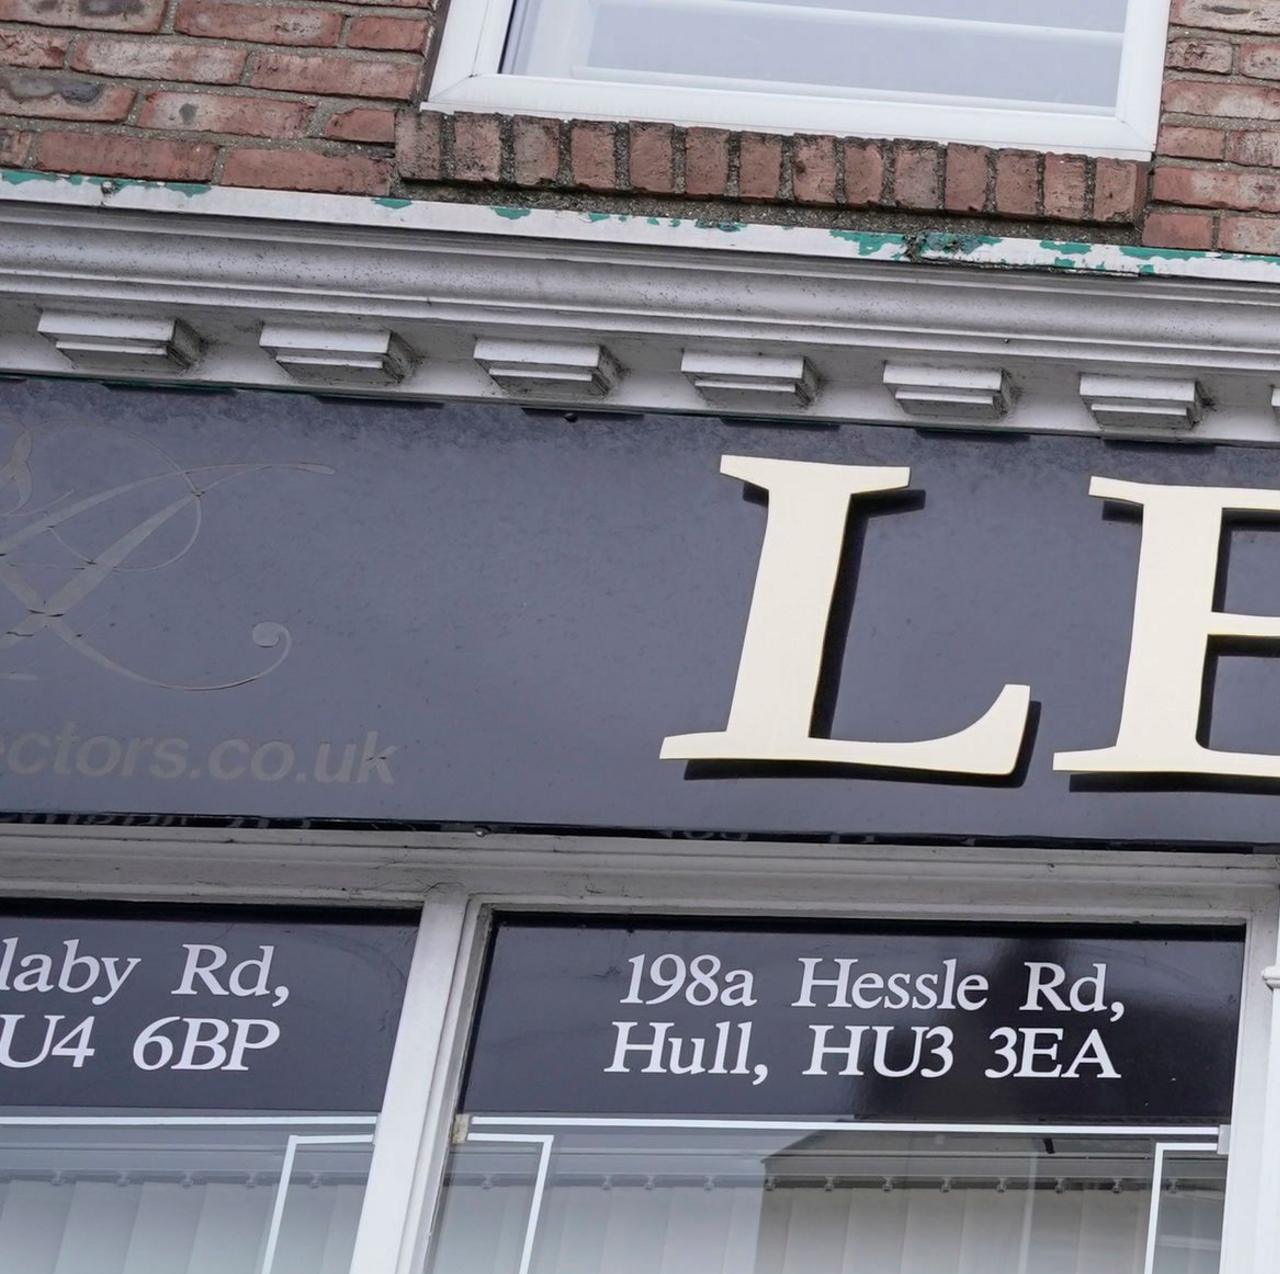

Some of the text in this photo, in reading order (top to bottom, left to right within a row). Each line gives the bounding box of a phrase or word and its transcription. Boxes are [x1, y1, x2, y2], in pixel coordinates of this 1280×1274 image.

[0, 722, 398, 785] ctors.co.uk
[171, 943, 290, 1008] Rd,
[619, 953, 1126, 1021] 198a Hessle Rd,
[132, 1015, 281, 1071] 6BP
[603, 1020, 1122, 1086] Hull, HU3 3EA
